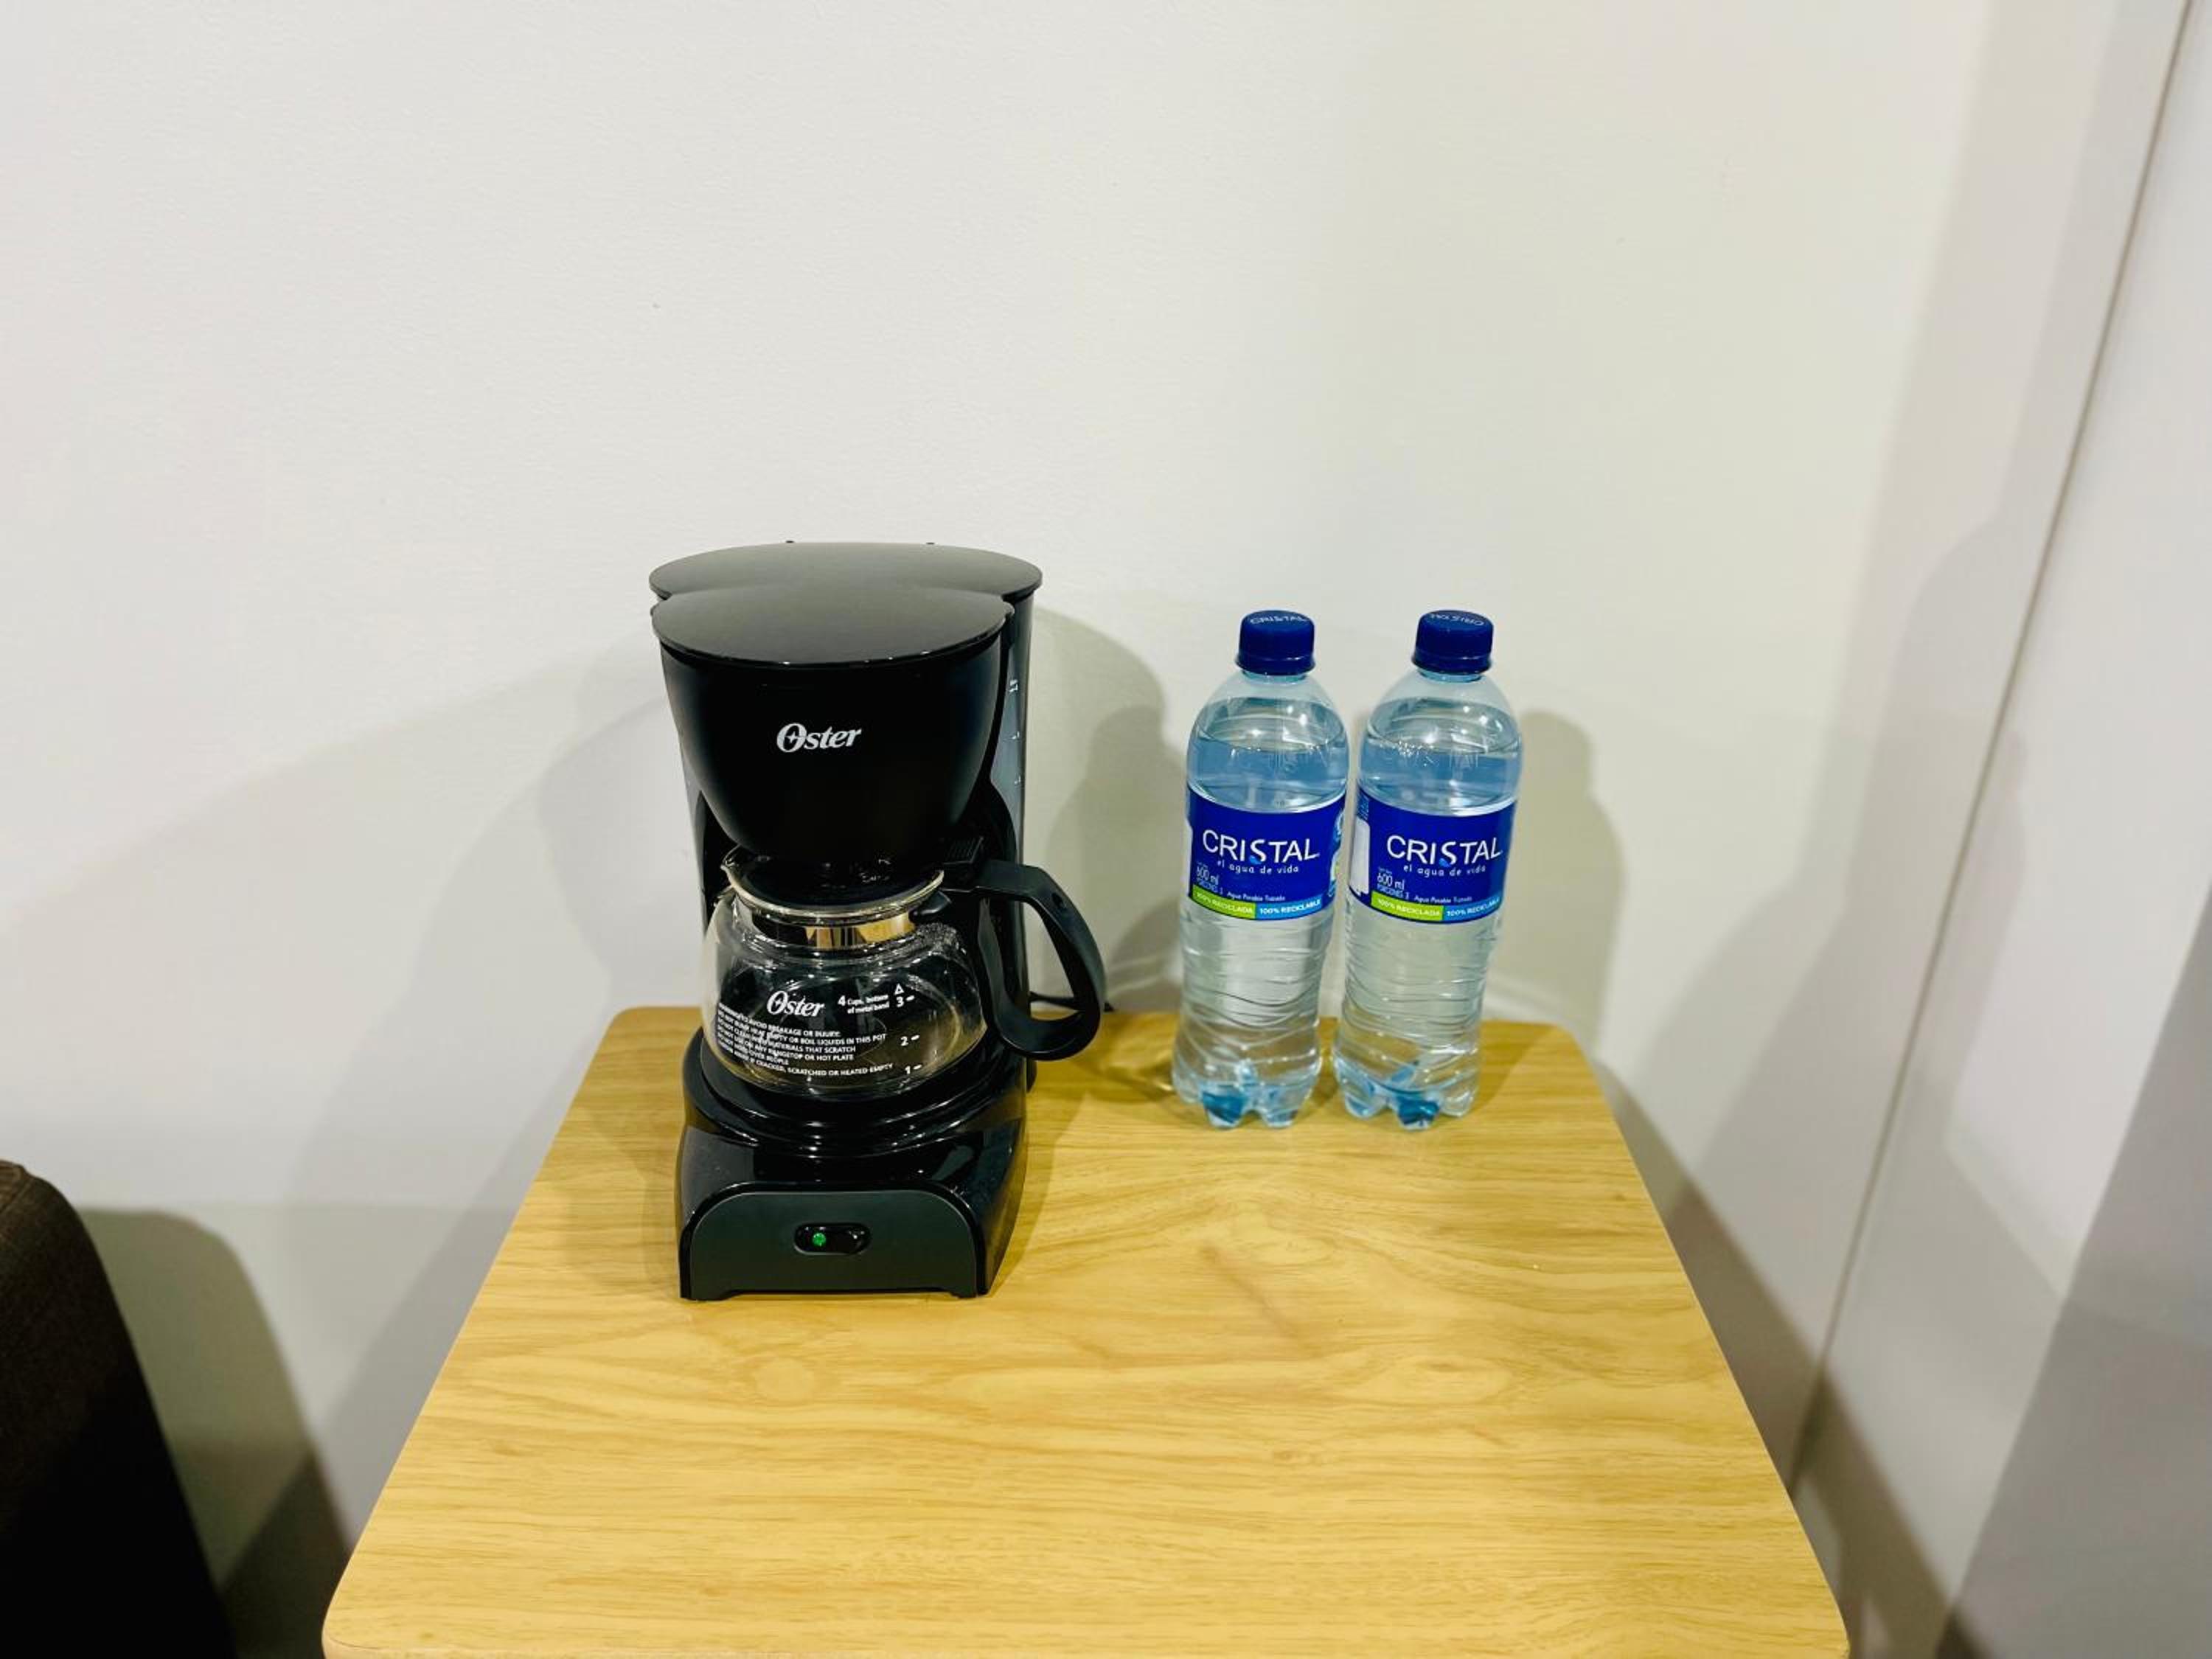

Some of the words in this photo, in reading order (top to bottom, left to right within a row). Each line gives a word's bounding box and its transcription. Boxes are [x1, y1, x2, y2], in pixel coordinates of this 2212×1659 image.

[776, 723, 862, 752] Oster
[1203, 830, 1321, 864] CRISTAL
[1387, 835, 1503, 866] CRISTAL
[1217, 860, 1225, 868] el
[1229, 863, 1255, 874] agua
[1260, 866, 1273, 874] de
[1277, 865, 1299, 874] vida
[1403, 864, 1413, 872] el
[1418, 867, 1445, 877] agua
[1450, 867, 1462, 876] de
[1467, 865, 1486, 874] vida
[1377, 872, 1393, 887] 600
[1394, 879, 1405, 890] ml
[1227, 891, 1242, 900] Agua
[1413, 894, 1430, 903] Agua
[1260, 907, 1280, 915] 100%
[767, 990, 825, 1017] Oster
[838, 995, 846, 1006] 4
[897, 996, 905, 1007] 3
[816, 1038, 846, 1046] LIQUIDS
[855, 1036, 872, 1044] THIS
[872, 1033, 888, 1042] POT
[900, 1036, 909, 1046] 2
[824, 1046, 856, 1054] SCRATCH
[832, 1053, 855, 1061] PLATE
[787, 1067, 827, 1077] SCRATCHED
[841, 1068, 869, 1077] HEATED
[869, 1062, 894, 1074] EMPTY
[905, 1065, 911, 1074] 1
